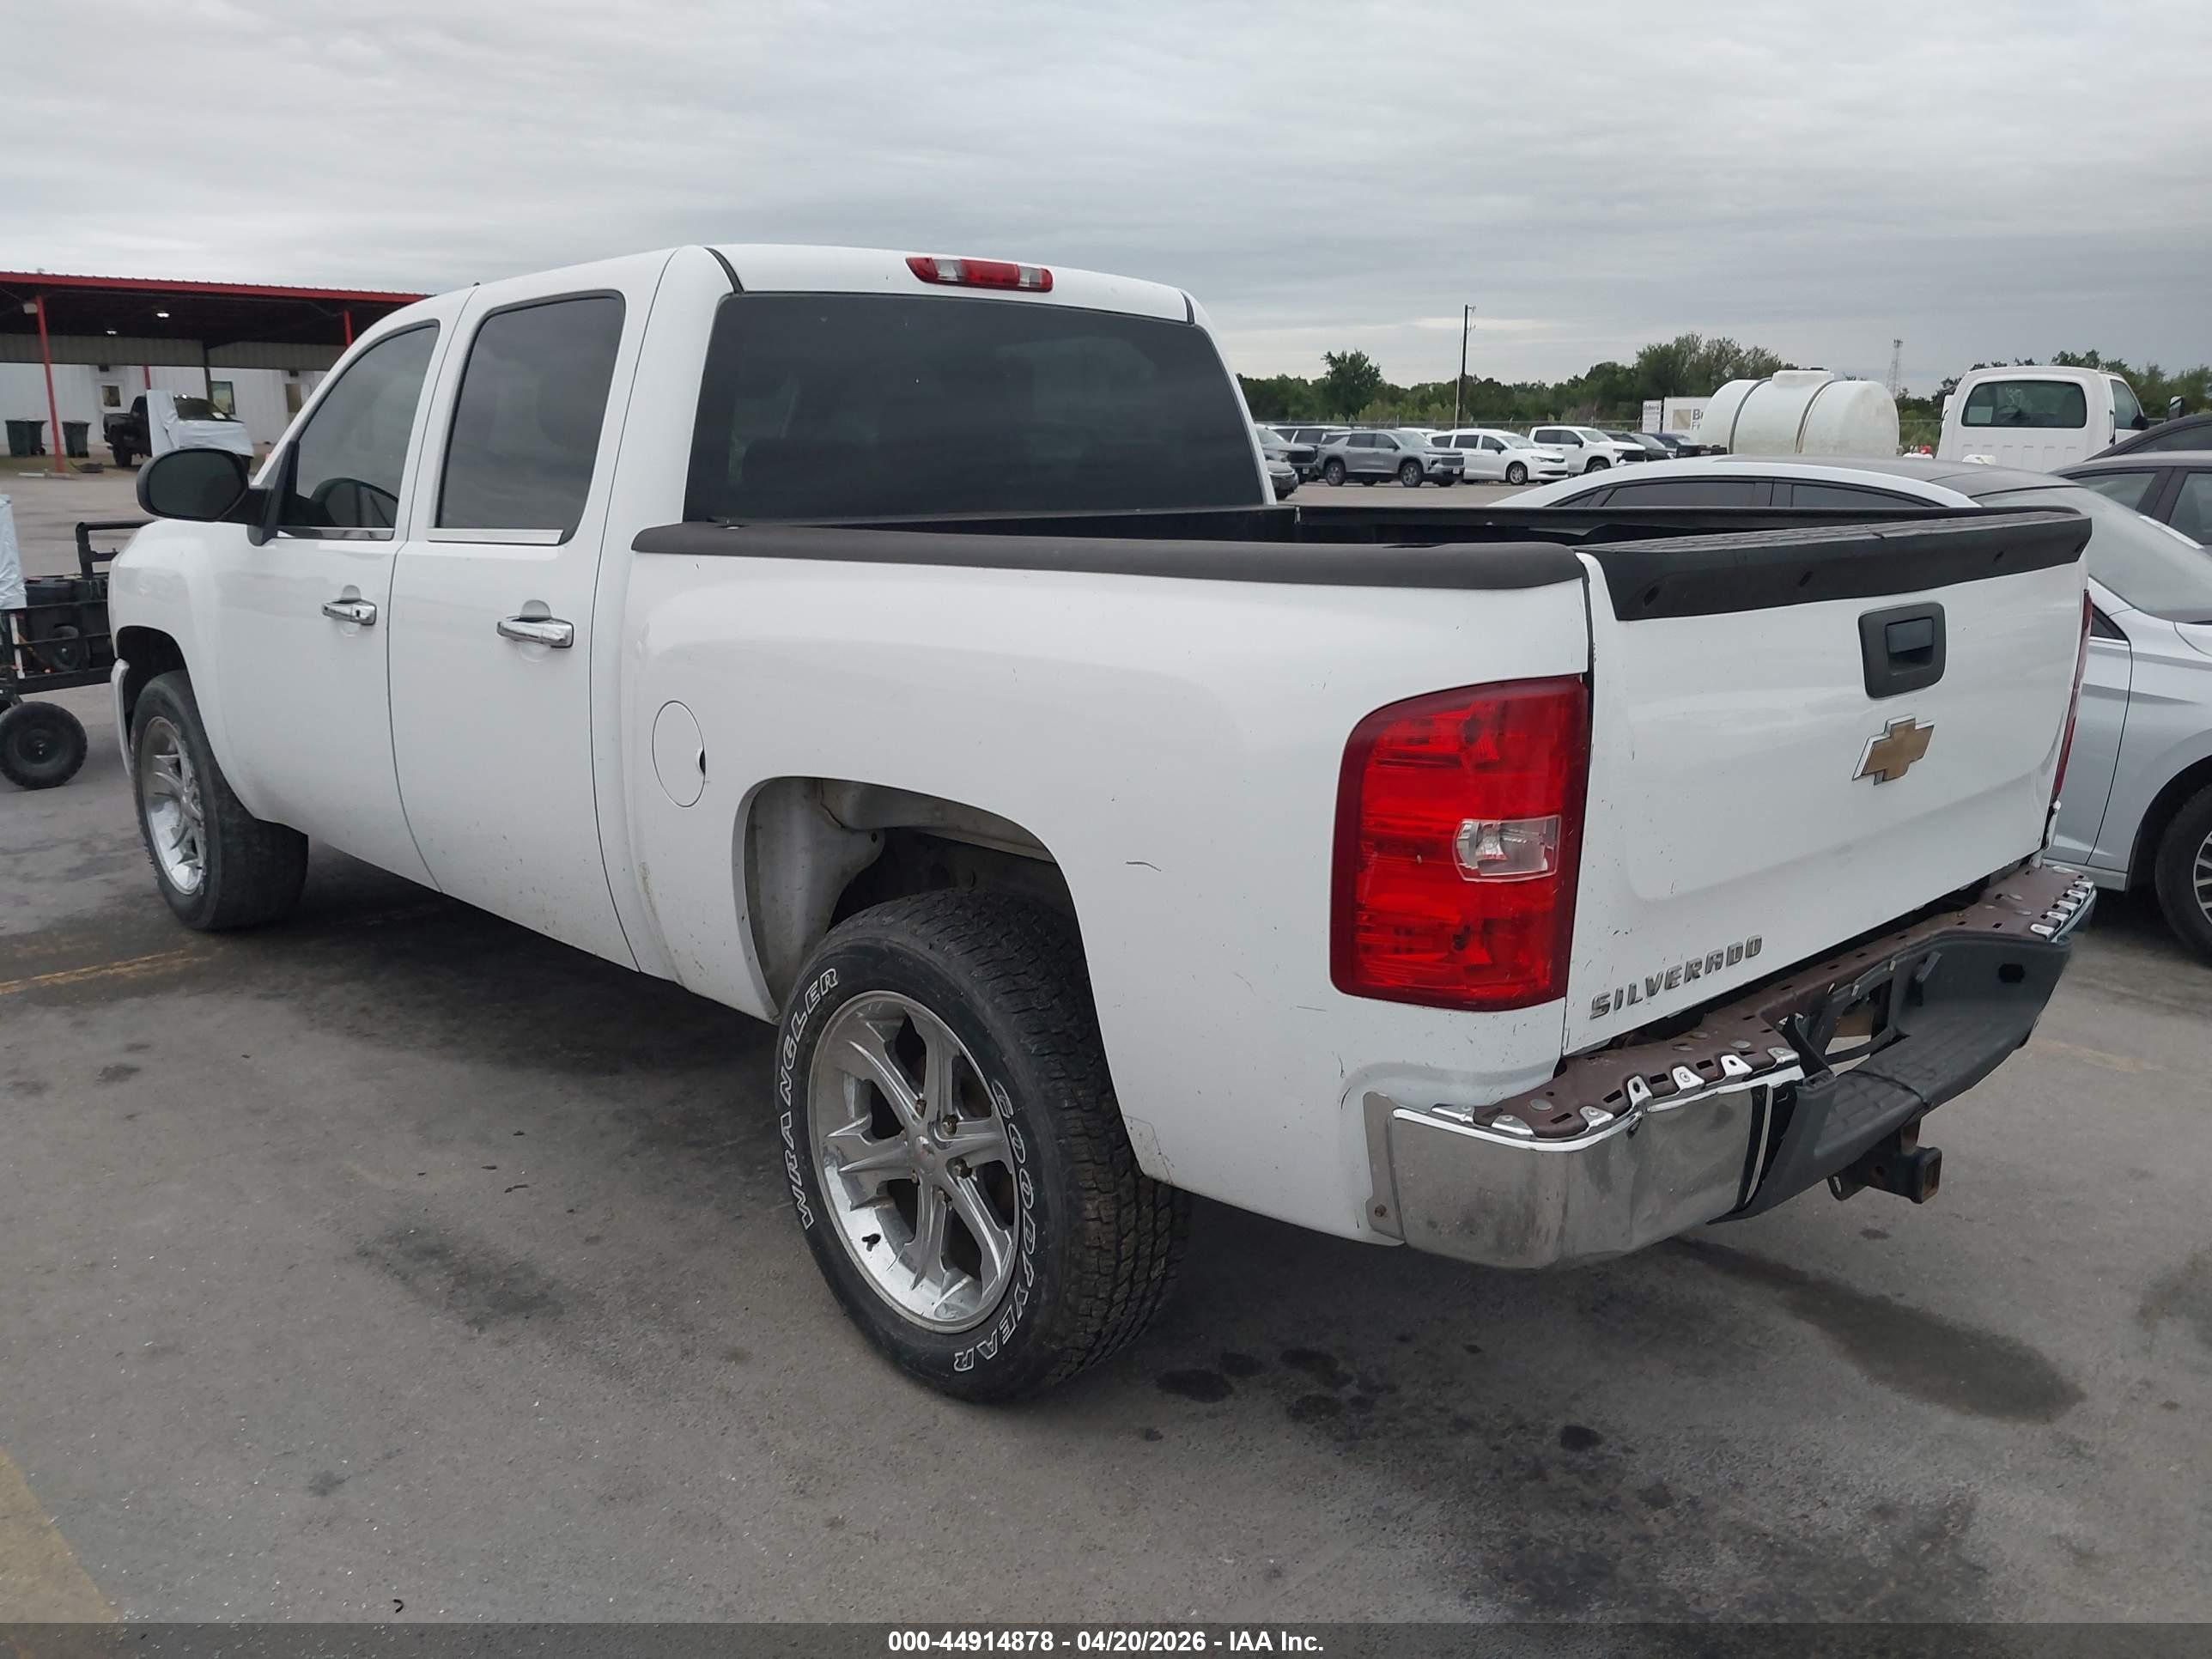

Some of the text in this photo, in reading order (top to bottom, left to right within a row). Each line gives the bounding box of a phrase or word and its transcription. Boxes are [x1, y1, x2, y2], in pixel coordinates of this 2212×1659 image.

[776, 966, 840, 1231] WRANGLER
[1589, 934, 1763, 1019] SILVERADO
[952, 1079, 1036, 1373] GOODYEAR
